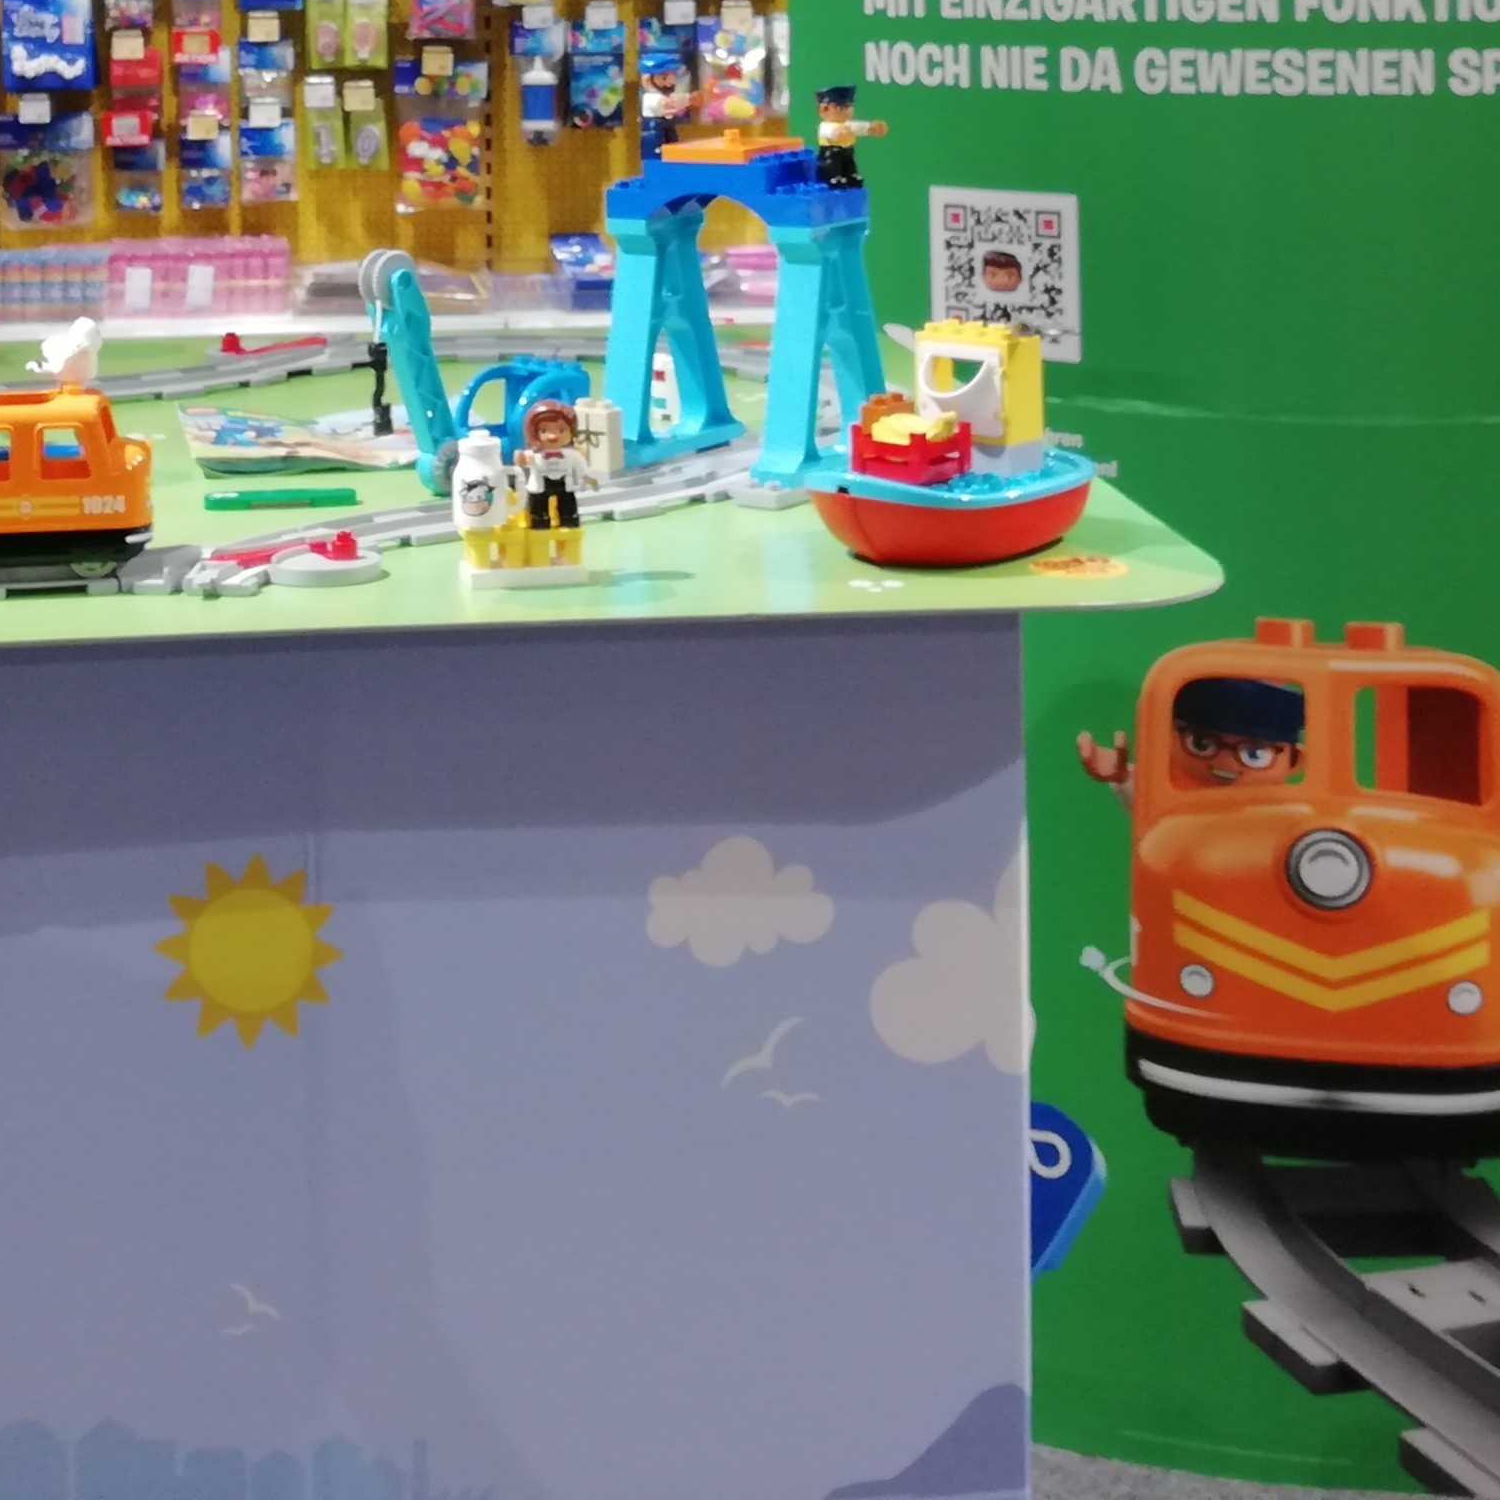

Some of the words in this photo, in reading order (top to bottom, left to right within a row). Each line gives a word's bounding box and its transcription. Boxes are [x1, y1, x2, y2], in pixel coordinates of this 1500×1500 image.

[864, 40, 970, 89] NOCH
[981, 44, 1049, 91] NIE
[1060, 46, 1123, 94] DA
[1134, 47, 1435, 97] GEWESENEN
